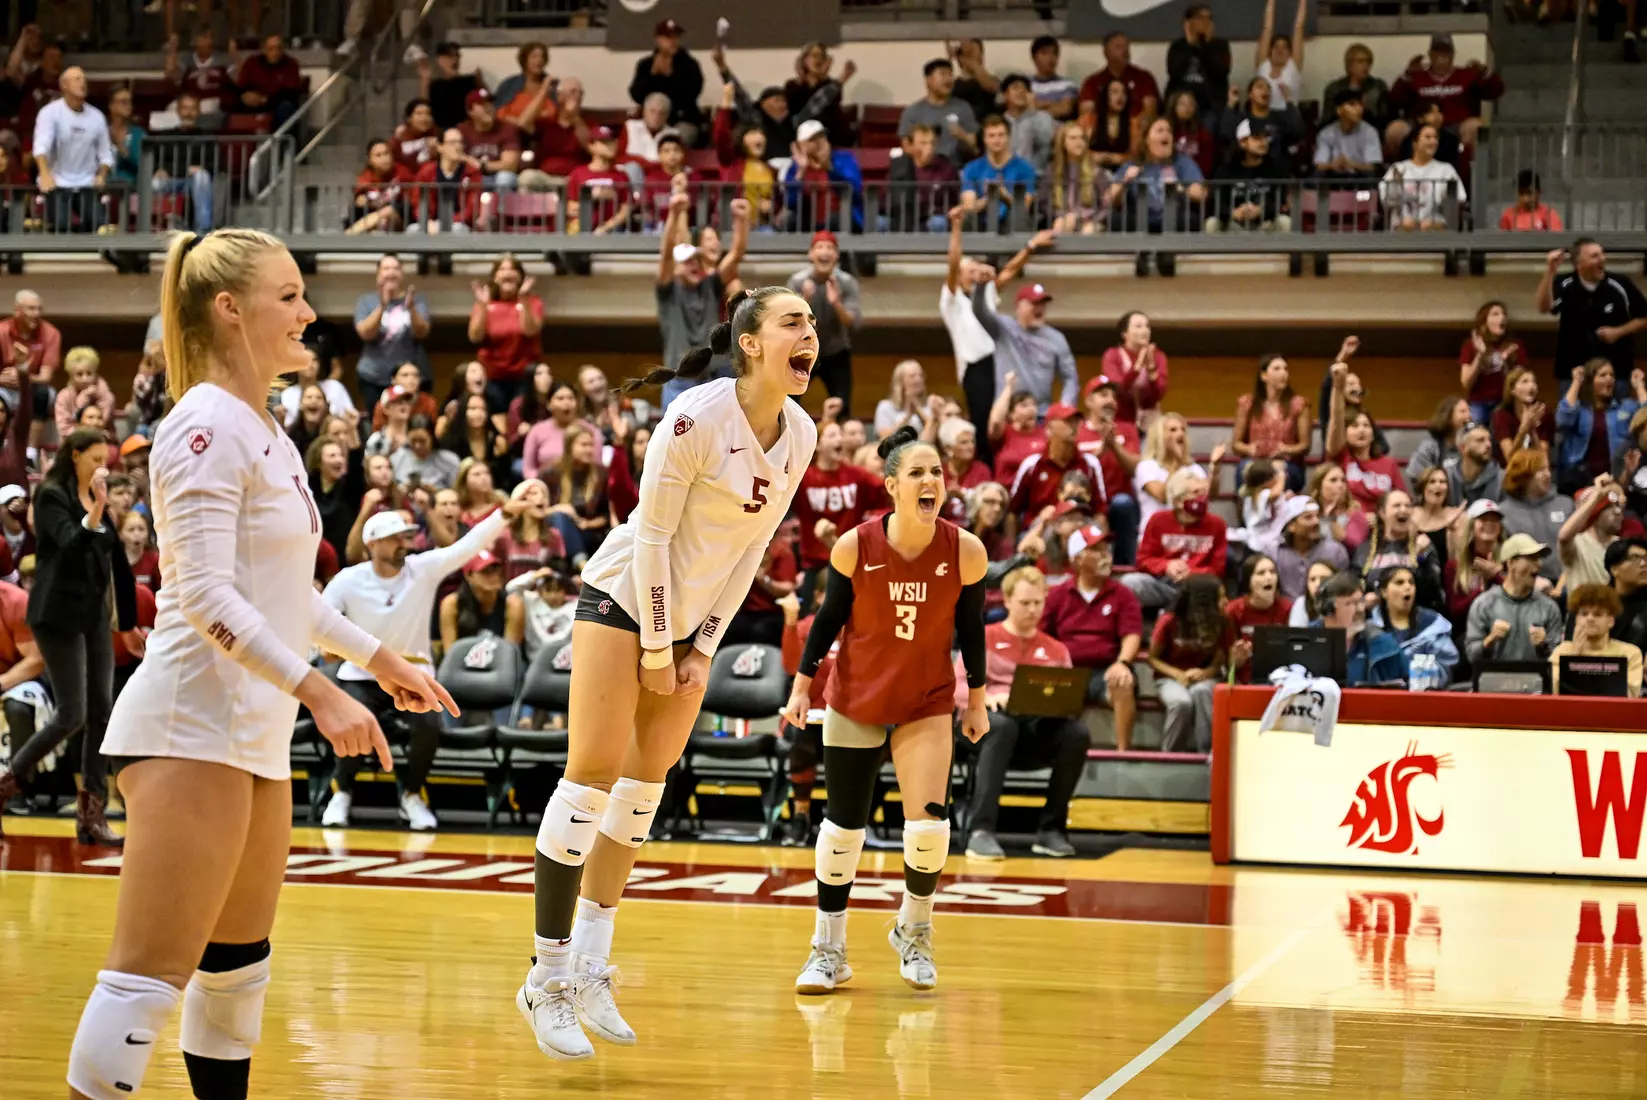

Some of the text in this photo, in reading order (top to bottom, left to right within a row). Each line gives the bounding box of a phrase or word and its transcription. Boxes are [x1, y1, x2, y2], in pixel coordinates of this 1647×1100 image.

[744, 476, 770, 513] 5
[807, 483, 858, 512] WSU
[888, 582, 927, 602] WSU
[651, 586, 666, 632] COUGARS
[895, 605, 917, 641] 3
[702, 615, 722, 638] WSU
